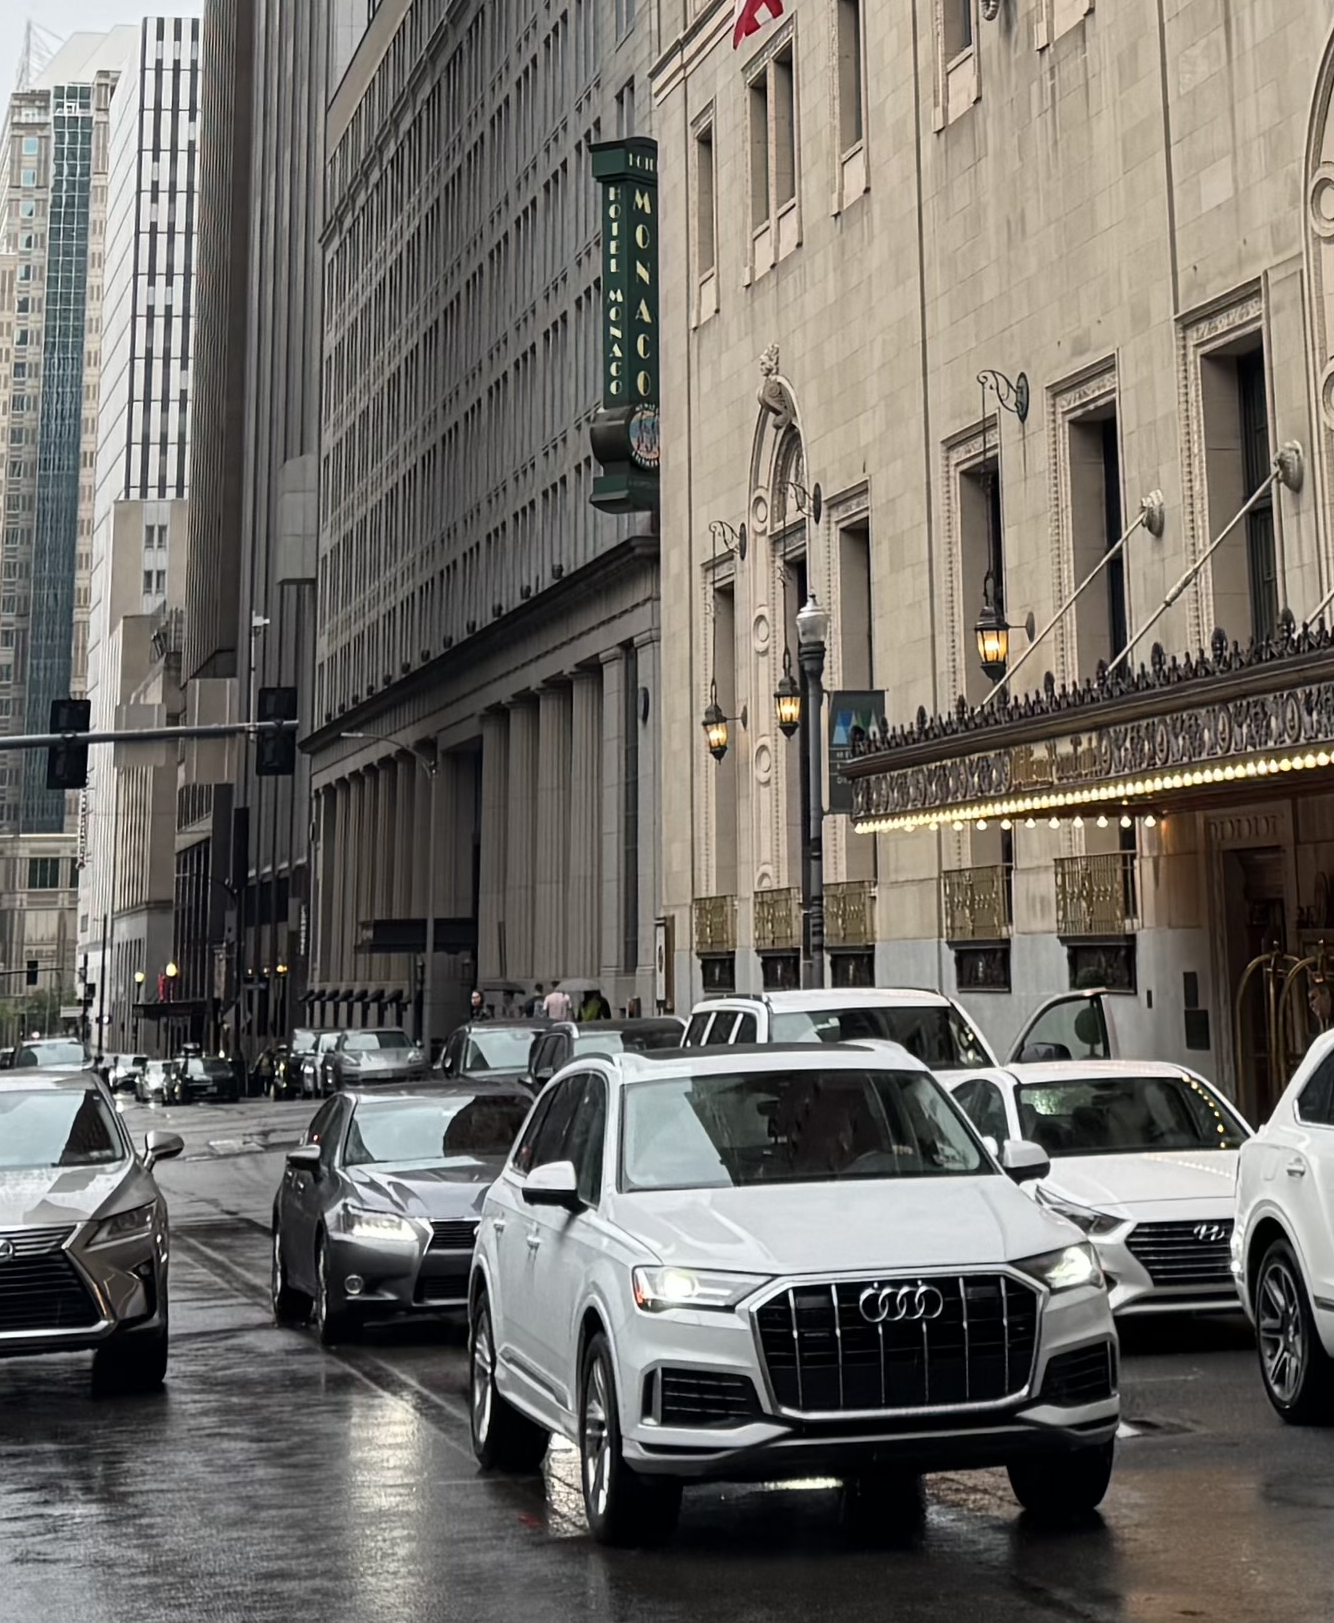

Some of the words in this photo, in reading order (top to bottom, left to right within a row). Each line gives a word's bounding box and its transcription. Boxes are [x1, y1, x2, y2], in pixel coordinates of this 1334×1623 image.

[608, 186, 622, 273] HOTEL
[607, 288, 624, 396] MONACO
[632, 188, 652, 397] MONACO
